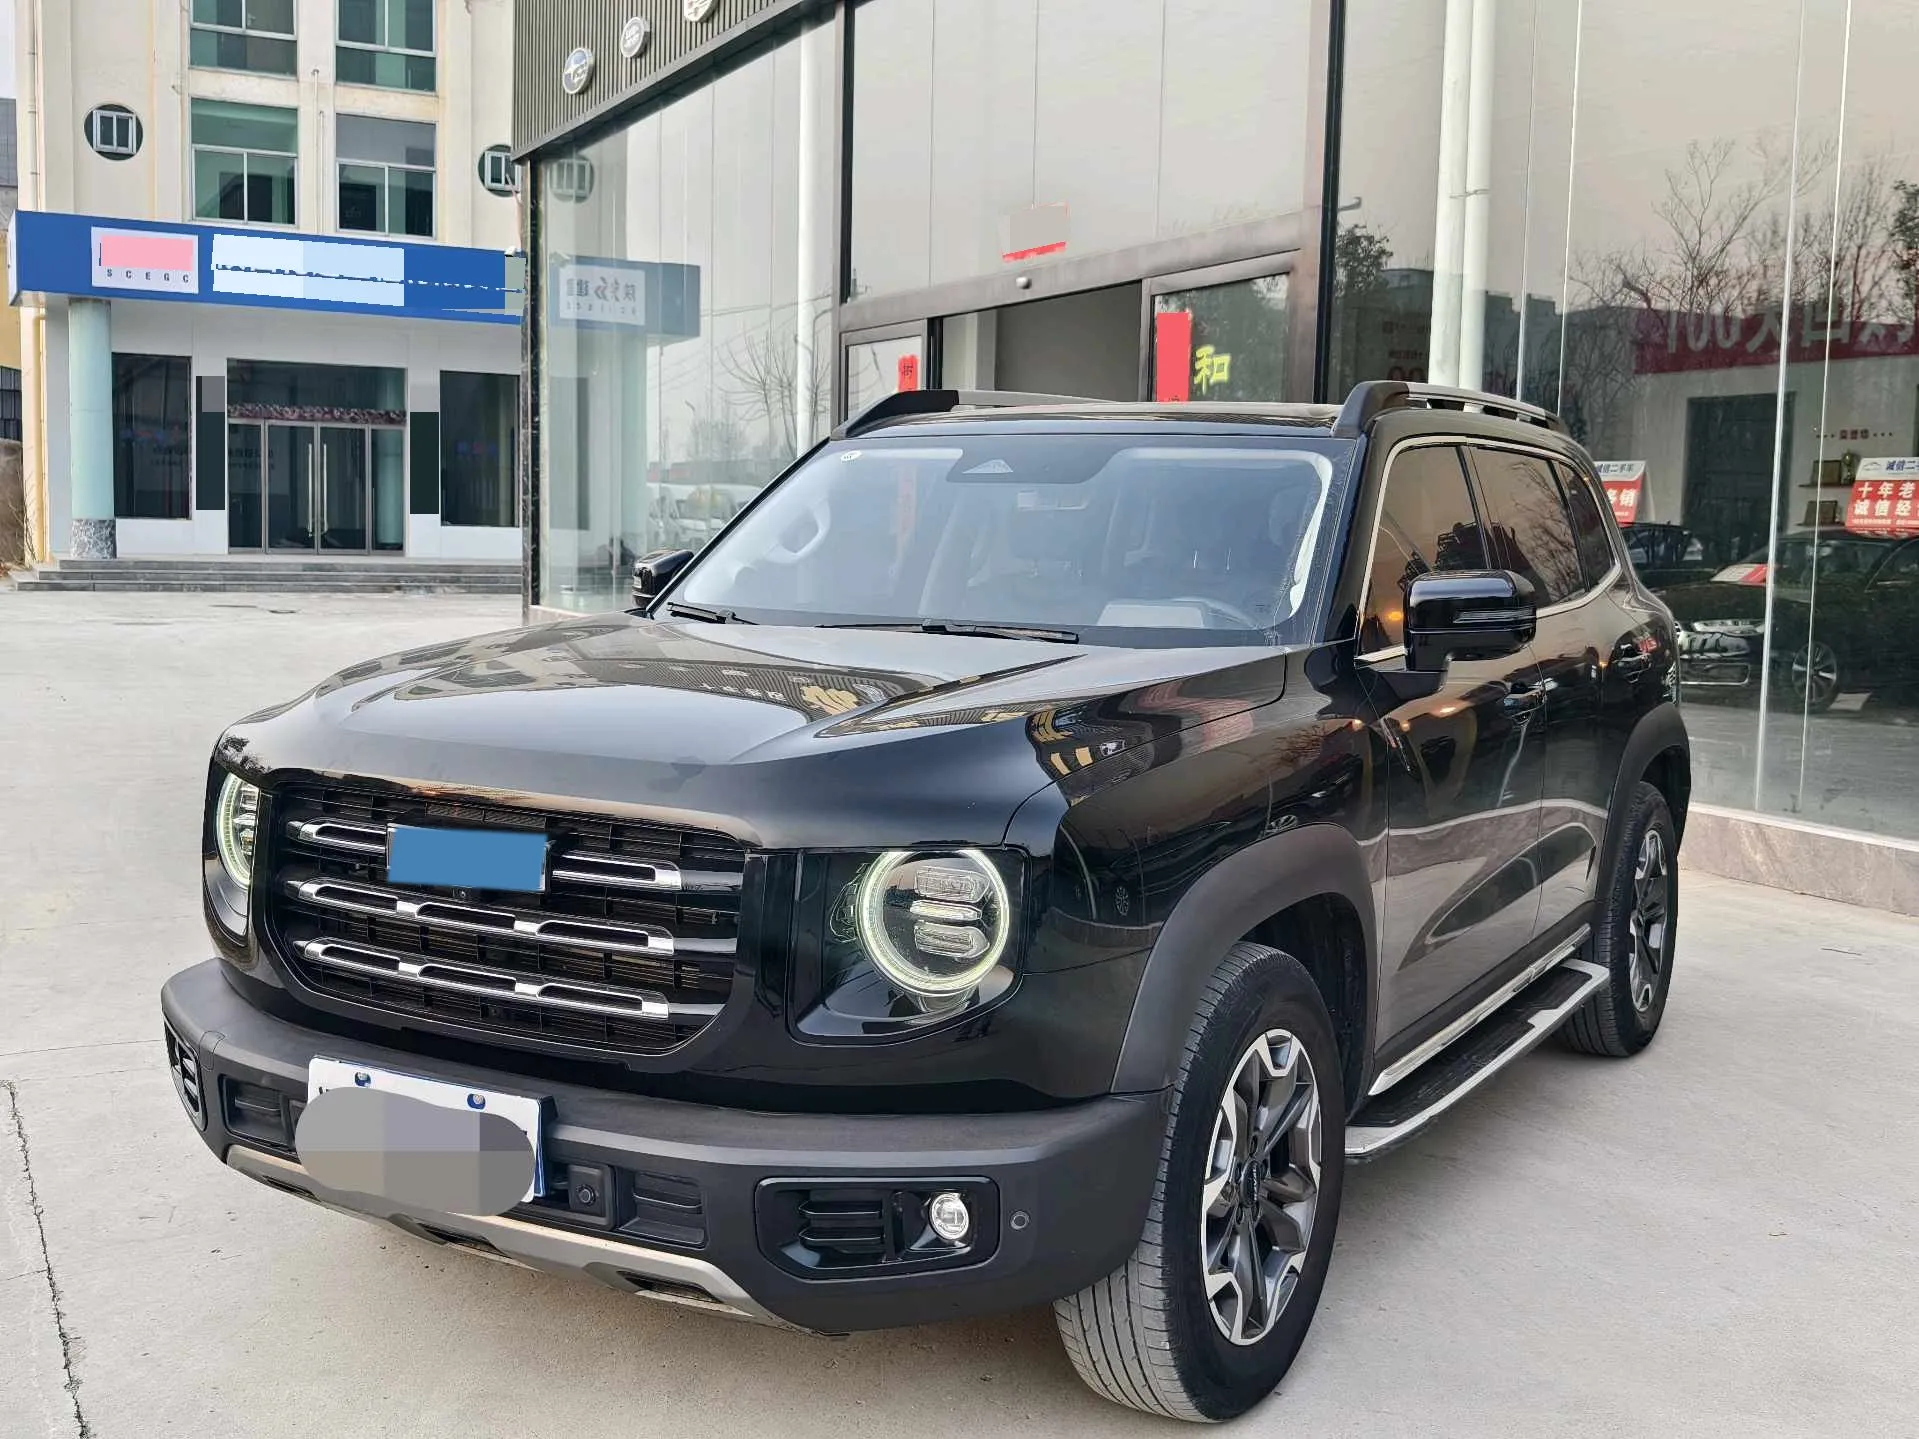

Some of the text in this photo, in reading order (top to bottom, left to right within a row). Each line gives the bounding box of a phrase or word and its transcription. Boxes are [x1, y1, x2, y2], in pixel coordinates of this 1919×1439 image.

[1193, 343, 1232, 396] 和
[1853, 499, 1919, 518] 诚信经
